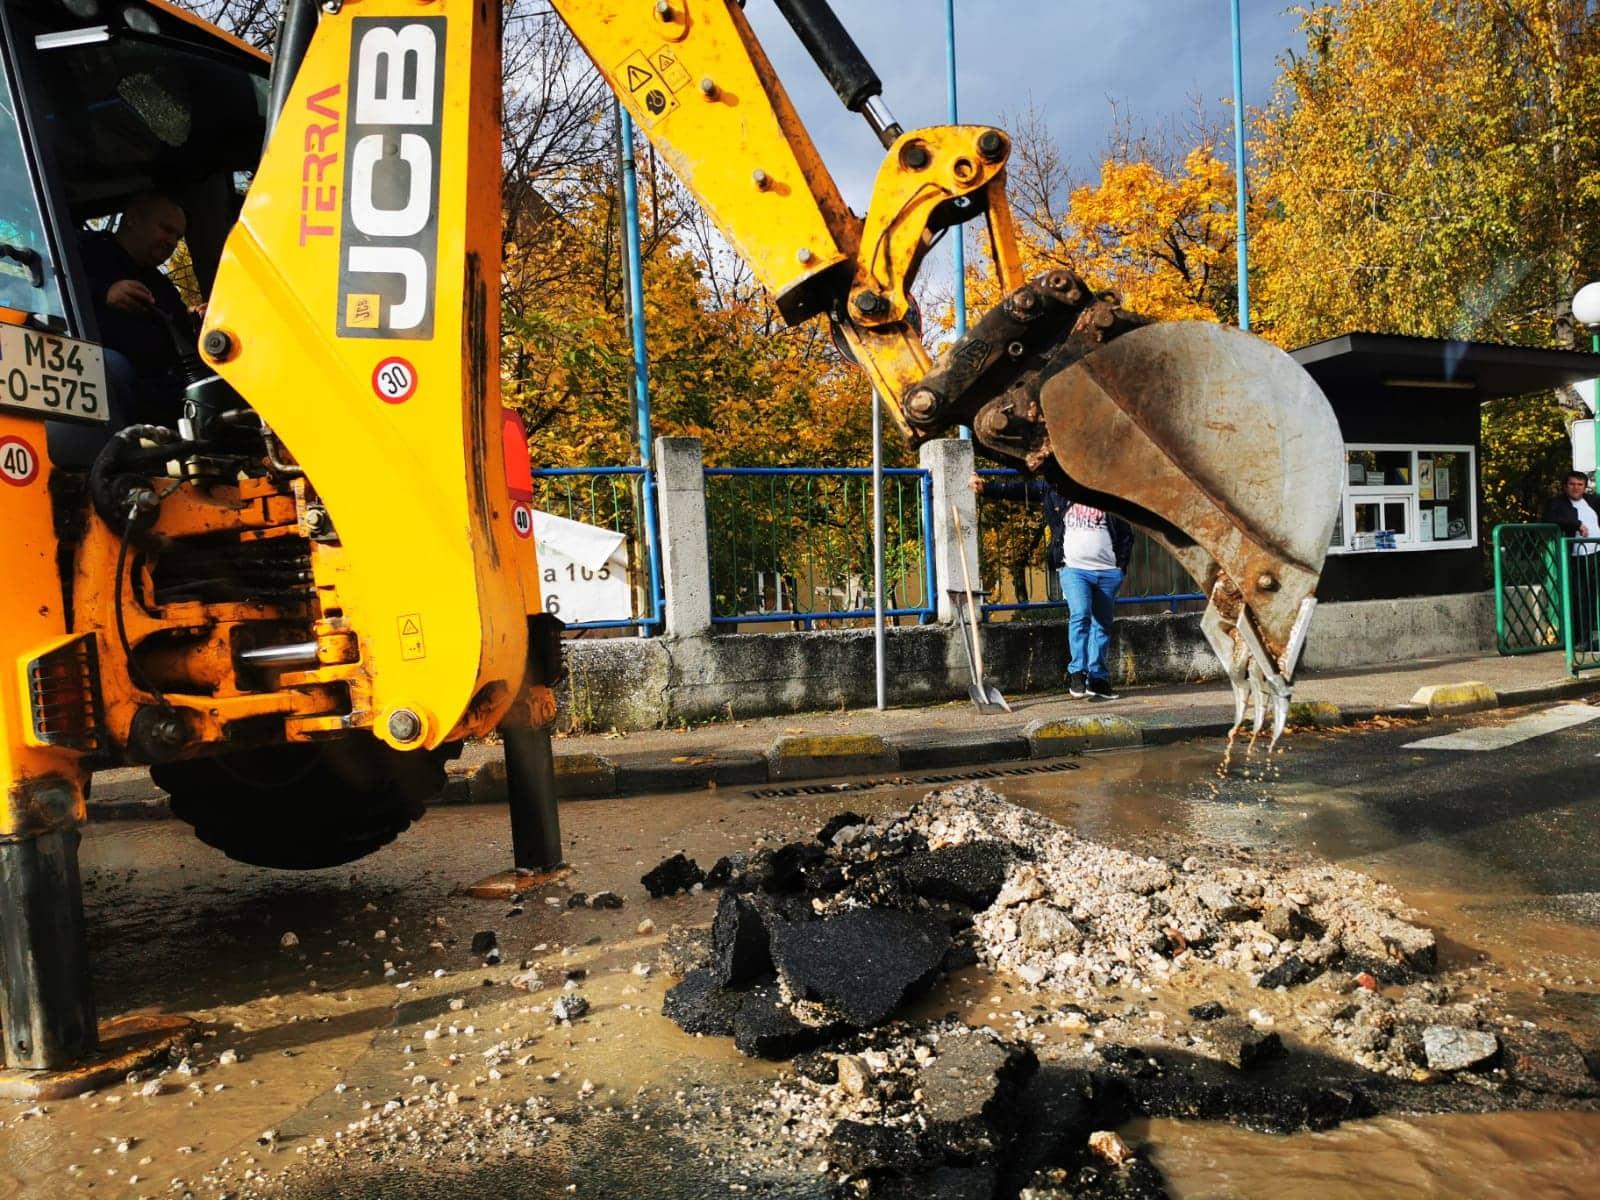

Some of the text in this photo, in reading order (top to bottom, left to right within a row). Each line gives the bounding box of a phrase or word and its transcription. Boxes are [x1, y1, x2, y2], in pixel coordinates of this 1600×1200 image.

[299, 84, 341, 247] TERRA
[348, 23, 437, 329] JCB
[24, 333, 84, 376] M34
[381, 366, 408, 394] 30
[4, 447, 28, 475] 40
[516, 511, 528, 529] 40
